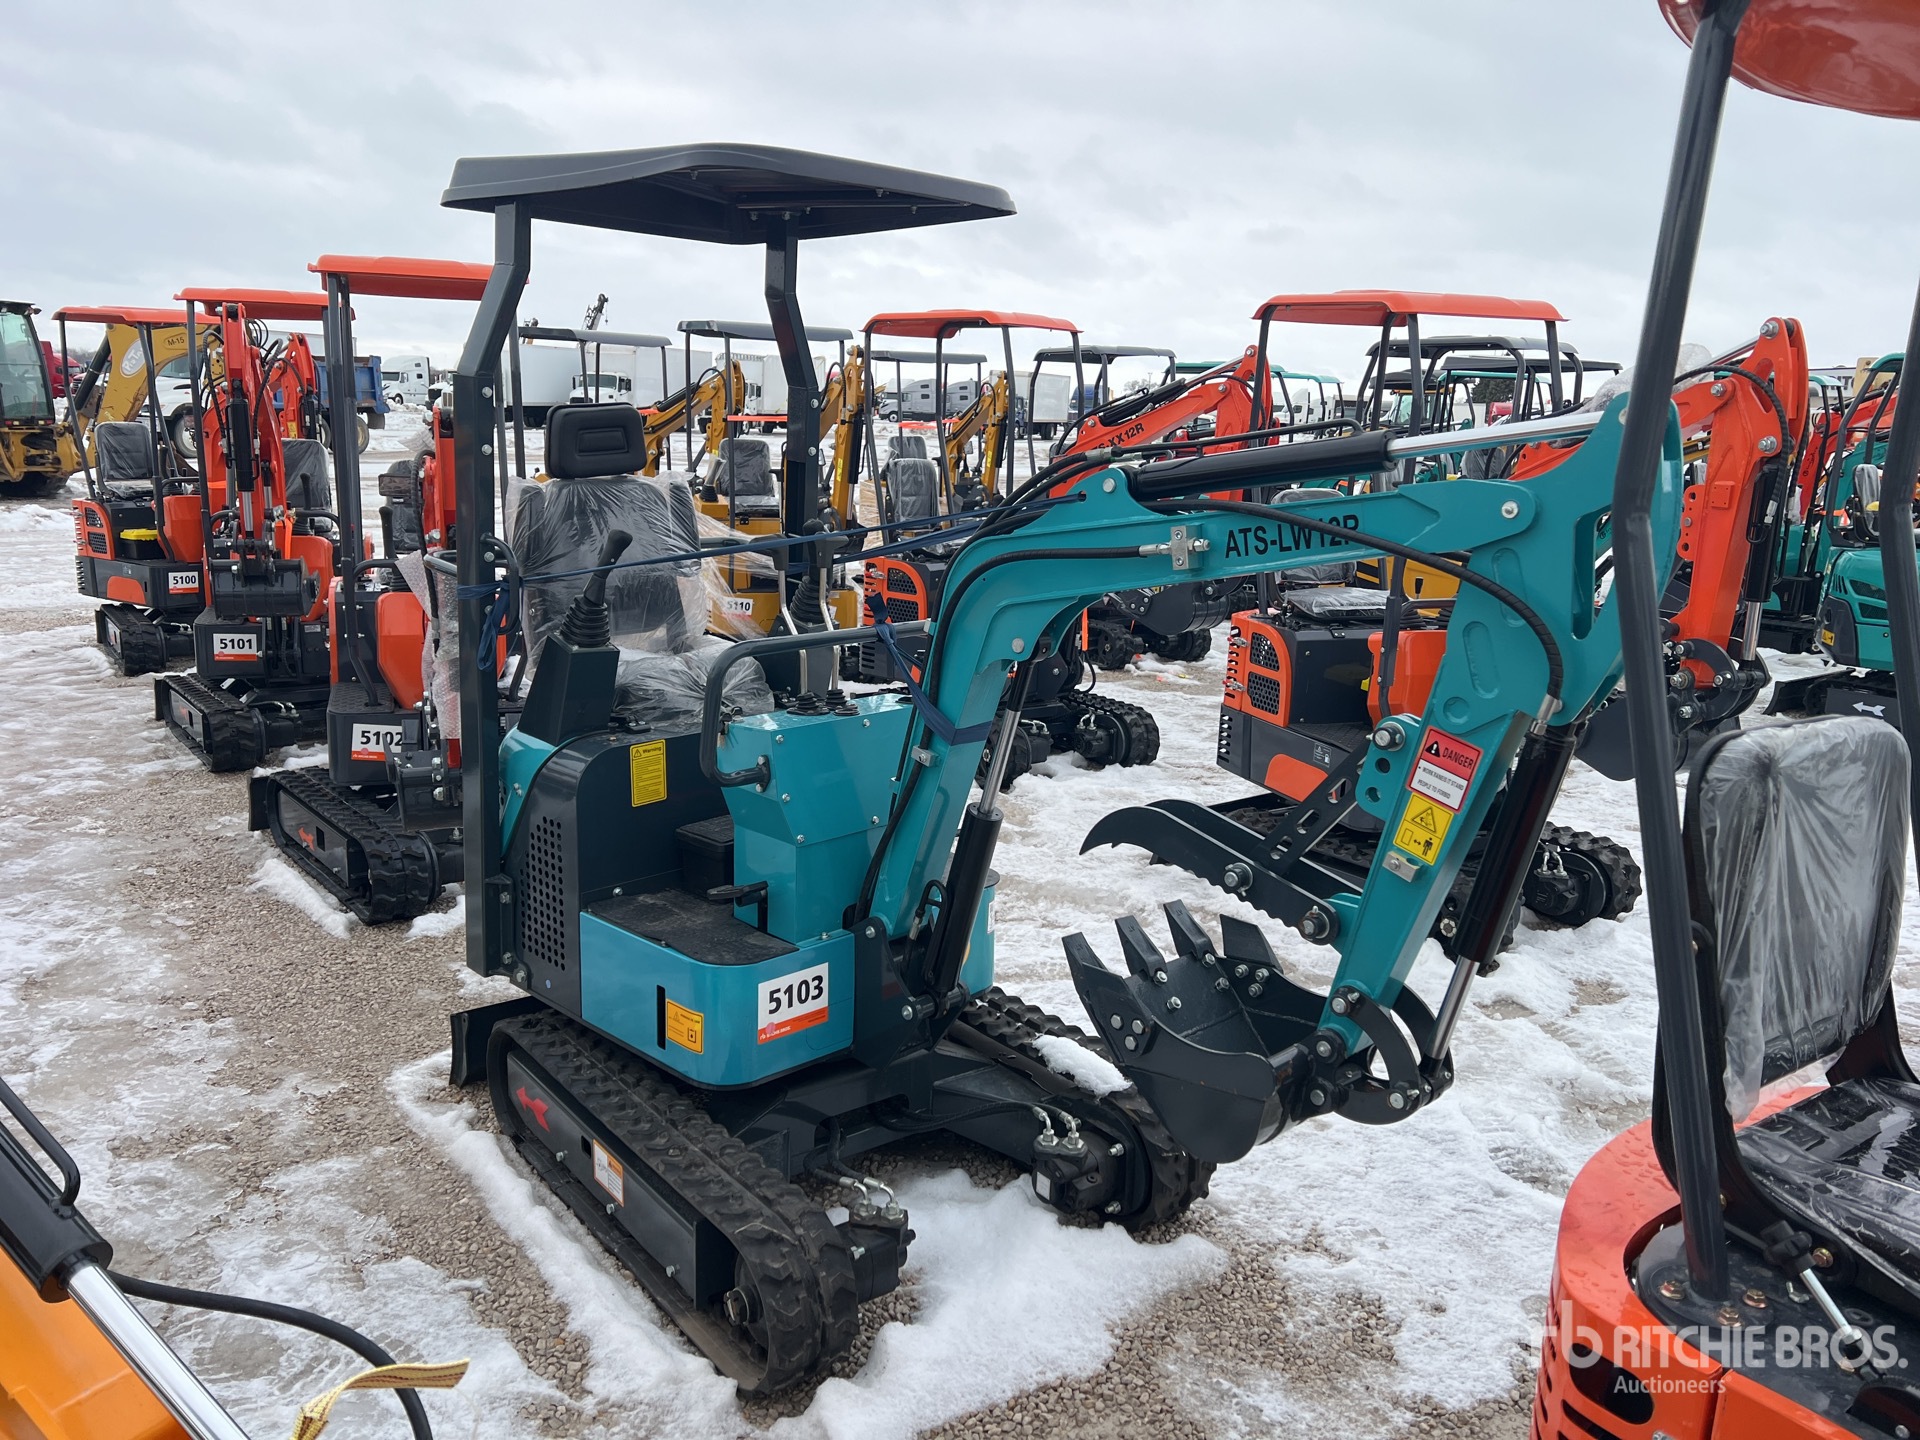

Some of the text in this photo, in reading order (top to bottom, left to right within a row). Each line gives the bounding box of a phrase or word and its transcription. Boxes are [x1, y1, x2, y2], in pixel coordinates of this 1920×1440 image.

[167, 336, 185, 346] M-15
[172, 575, 197, 585] 5100
[219, 638, 253, 650] 5101
[360, 730, 403, 747] 5102
[1442, 747, 1474, 769] DANGER
[768, 975, 824, 1015] 5103
